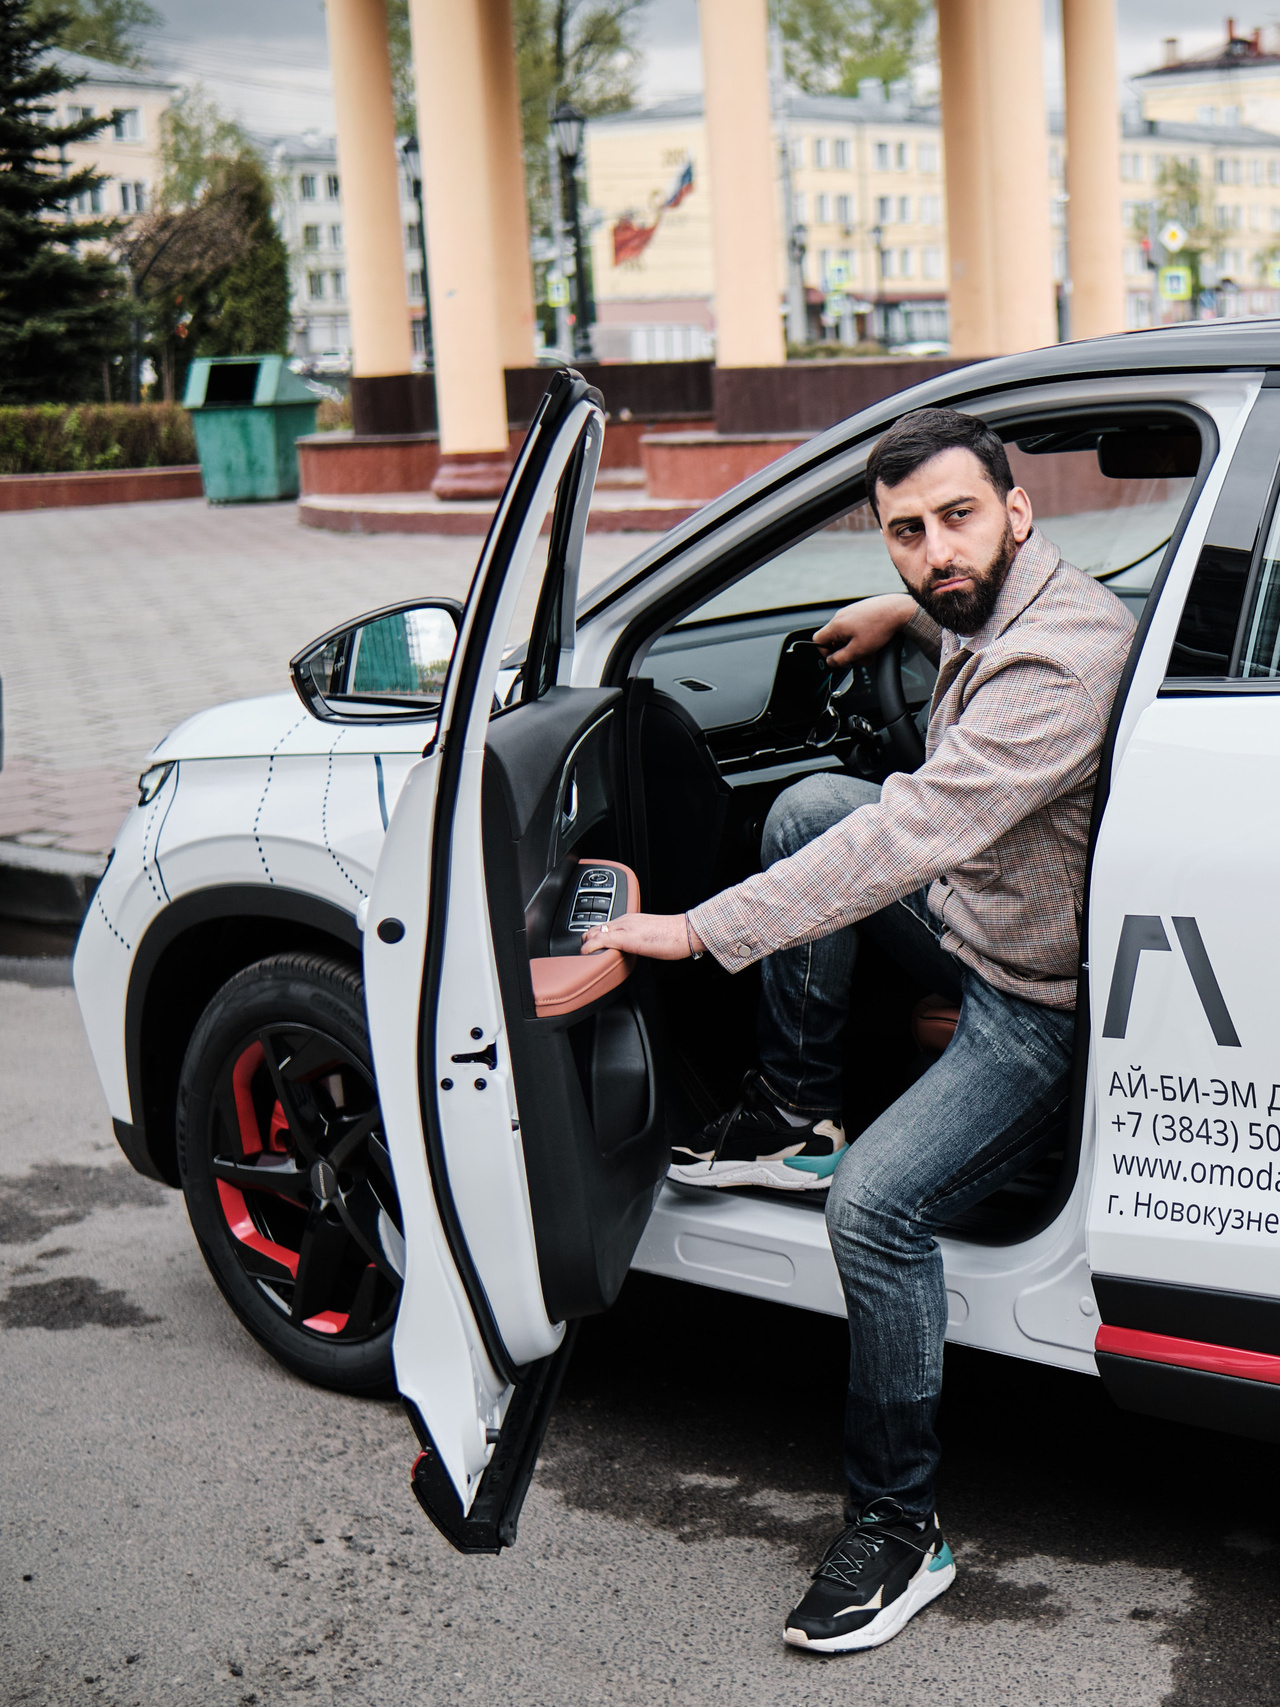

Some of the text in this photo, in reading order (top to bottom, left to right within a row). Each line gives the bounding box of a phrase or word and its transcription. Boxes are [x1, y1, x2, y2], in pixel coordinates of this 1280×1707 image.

[1108, 1064, 1257, 1109] АЙ-БИ-ЭМ
[1111, 1111, 1143, 1138] +7
[1152, 1113, 1239, 1154] (3843)
[1107, 1194, 1124, 1216] г.
